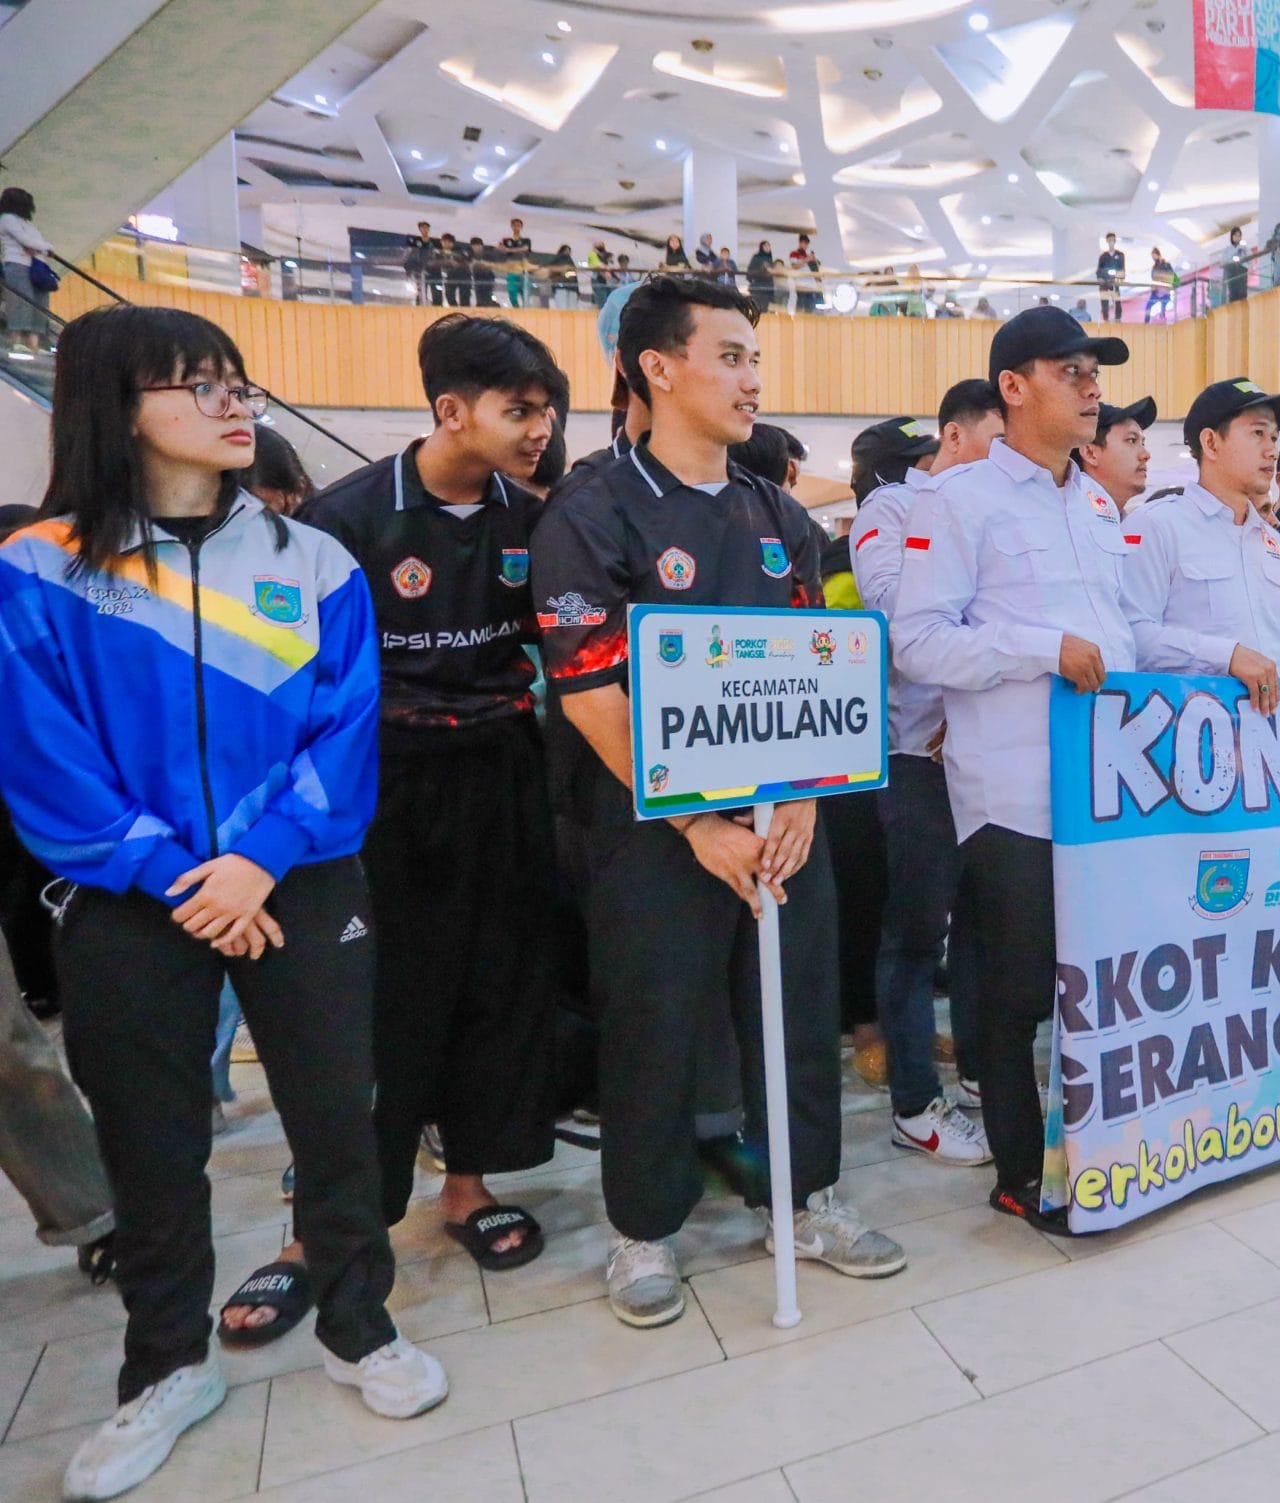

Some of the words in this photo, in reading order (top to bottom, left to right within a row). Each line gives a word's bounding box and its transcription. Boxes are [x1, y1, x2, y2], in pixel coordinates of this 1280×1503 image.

[383, 631, 431, 649] IPSI
[735, 639, 767, 649] PORKOT
[735, 650, 766, 659] TANGSEL
[722, 678, 818, 697] KECAMATAN
[661, 697, 868, 750] PAMULANG
[1056, 933, 1228, 1034] RKOT
[477, 1212, 524, 1233] RUGEN
[239, 1274, 294, 1295] RUGEN
